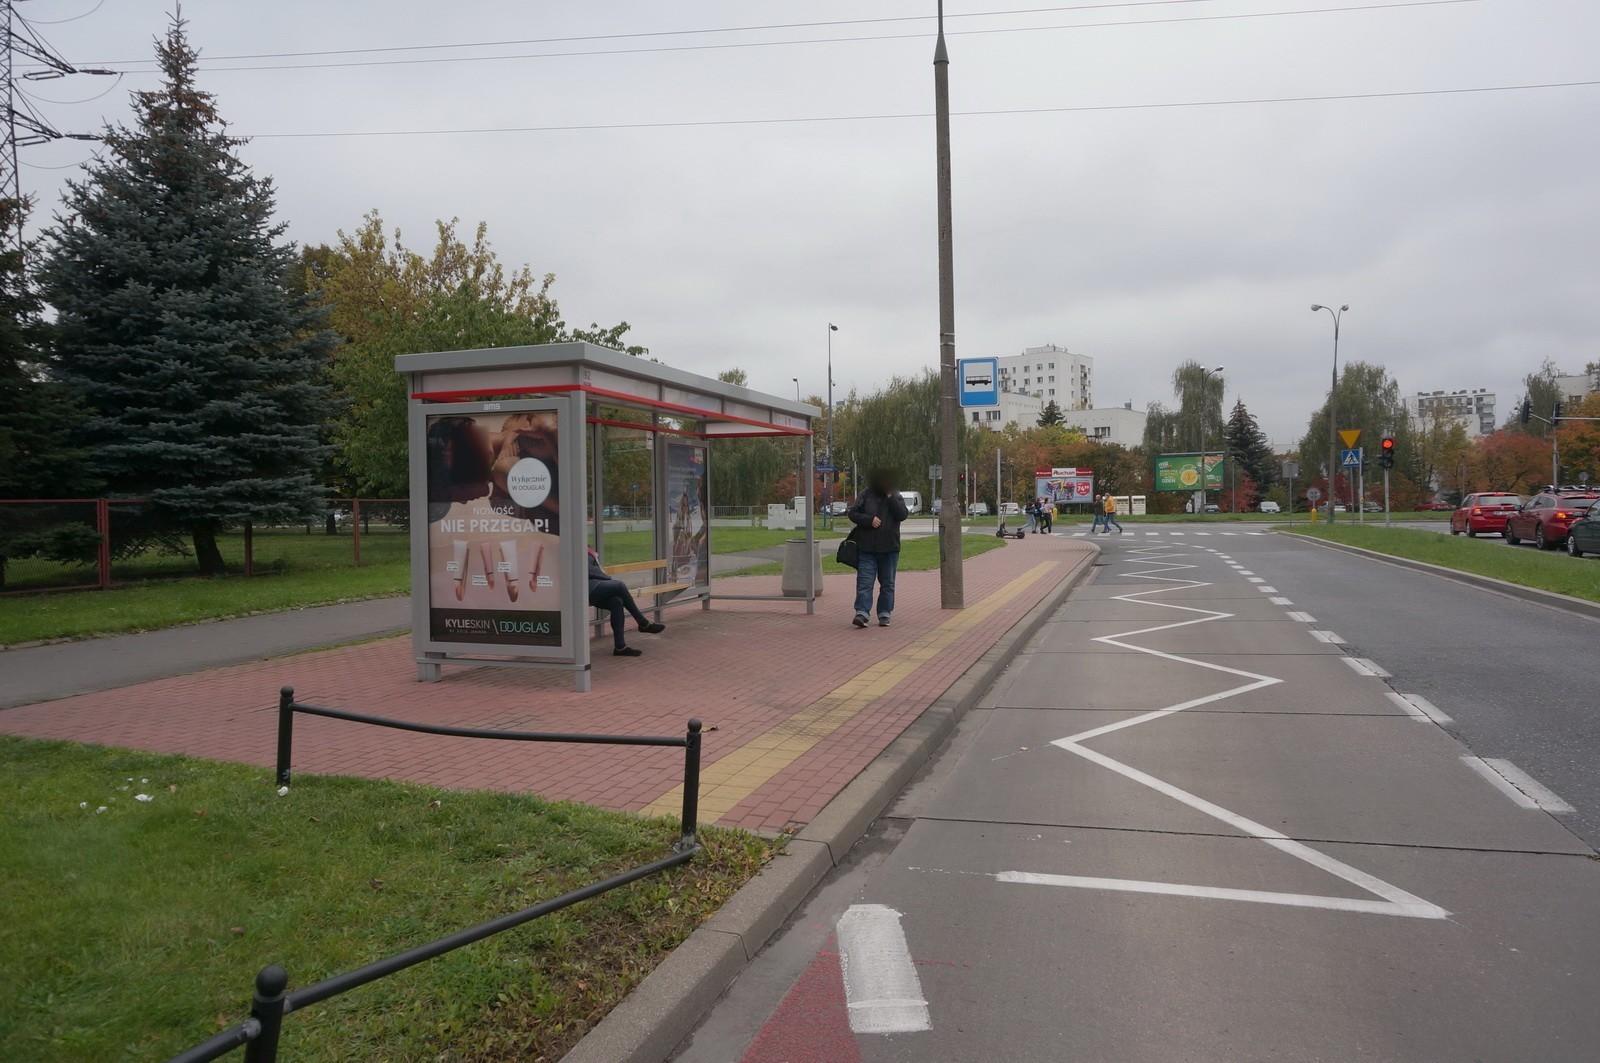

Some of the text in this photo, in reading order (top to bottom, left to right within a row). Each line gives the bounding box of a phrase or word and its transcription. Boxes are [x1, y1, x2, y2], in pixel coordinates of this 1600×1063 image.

[473, 505, 514, 516] NOWOŚĆ
[440, 519, 549, 533] NIE PRZEGAP!
[500, 621, 550, 634] DOUGLAS
